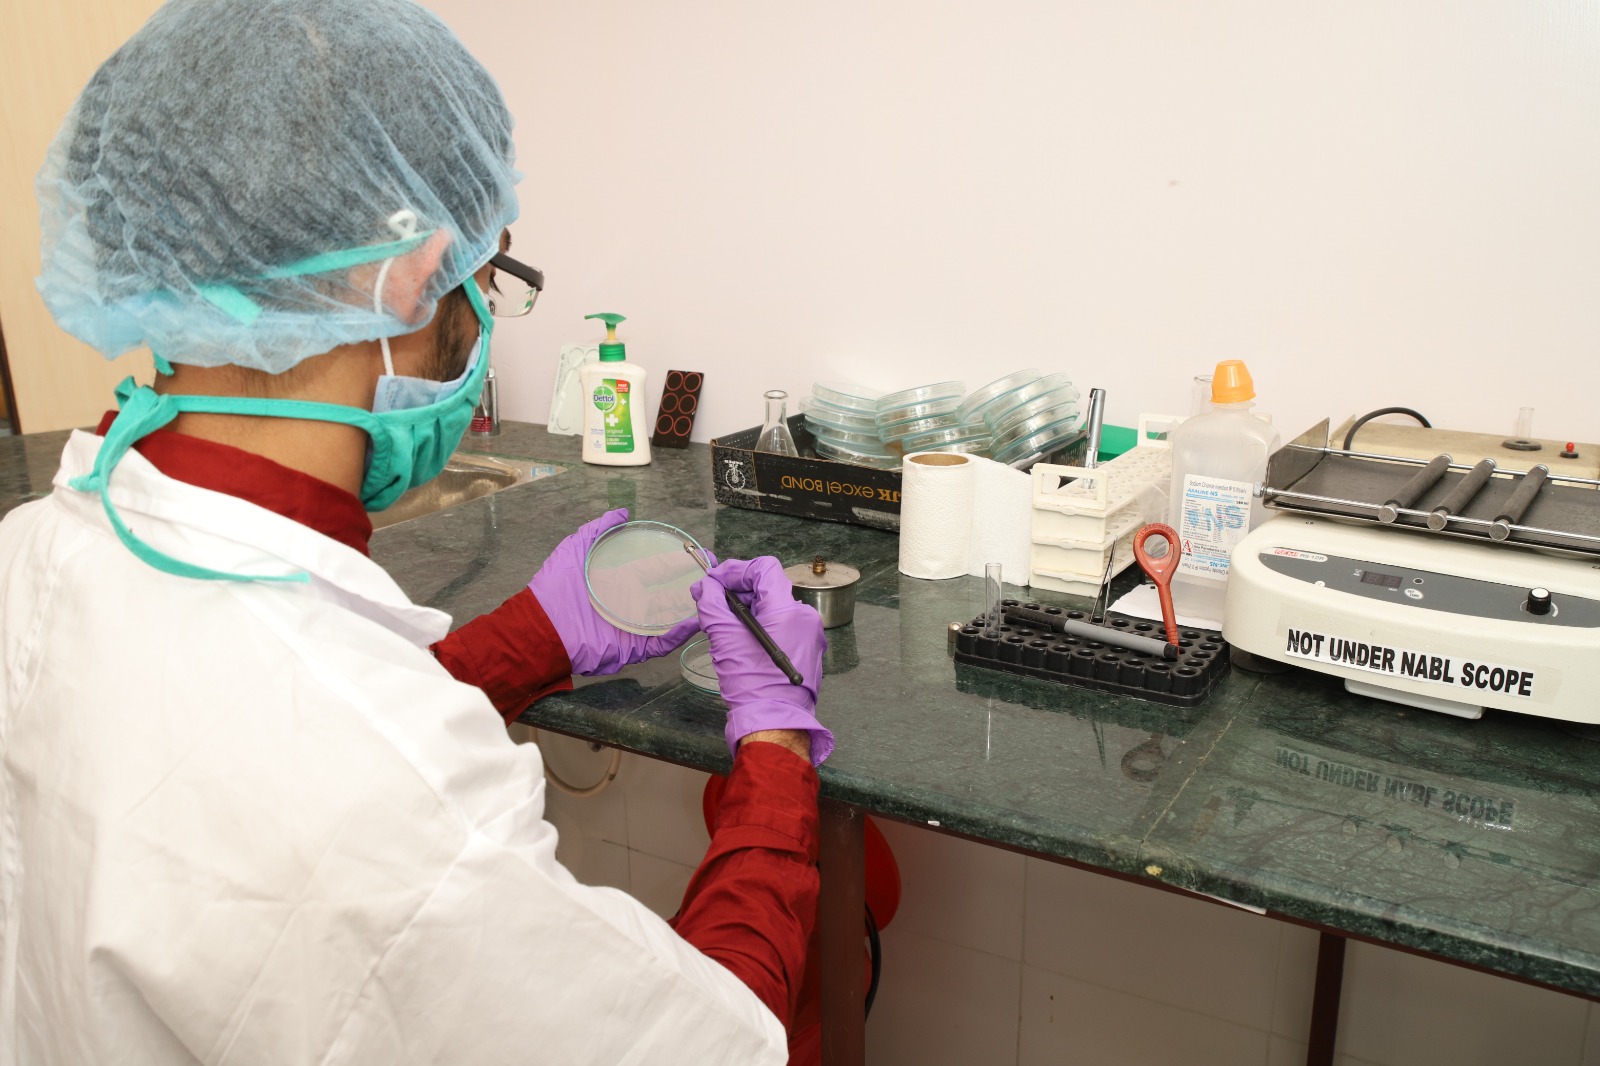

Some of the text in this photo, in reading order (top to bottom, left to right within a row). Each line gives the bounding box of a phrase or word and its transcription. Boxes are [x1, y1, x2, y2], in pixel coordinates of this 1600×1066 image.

[593, 394, 614, 402] Dettol
[781, 475, 901, 502] JK excel BOND
[1287, 628, 1534, 697] NOT UNDER NABL SCOPE
